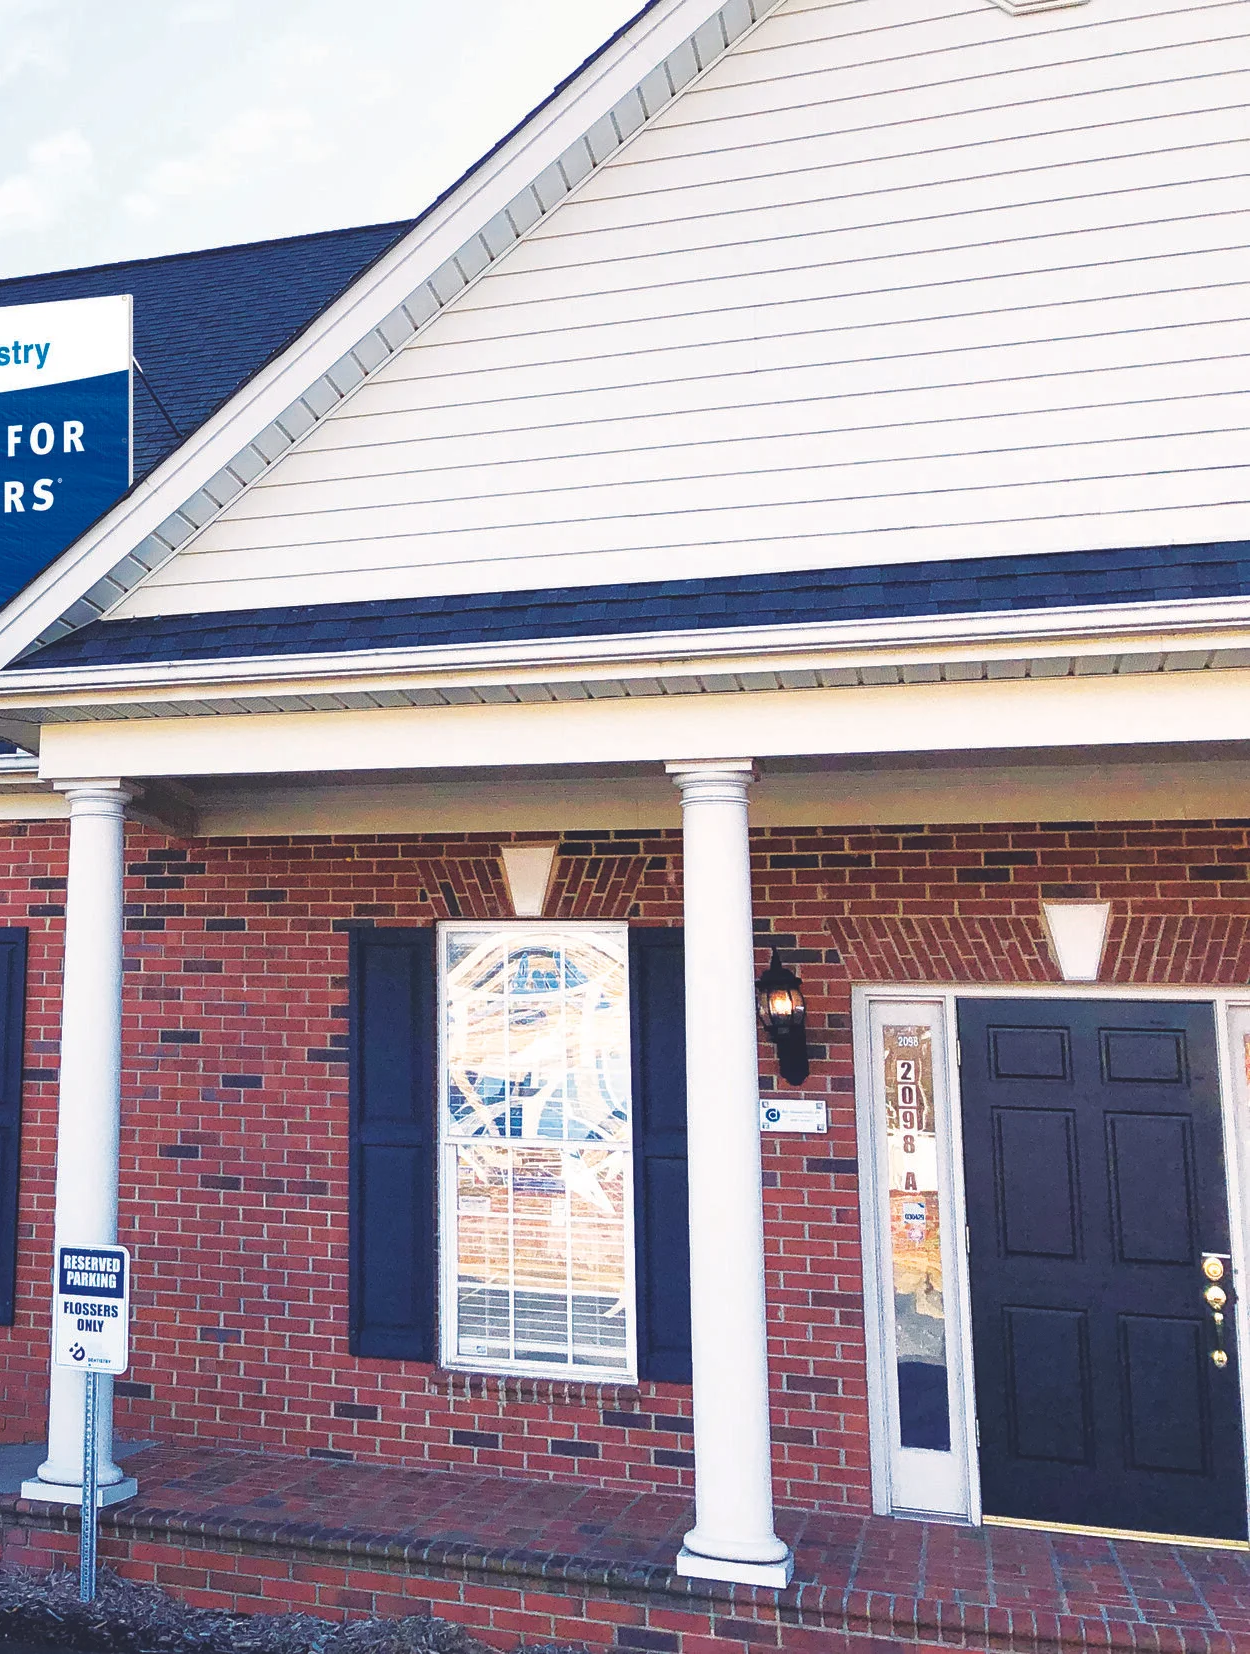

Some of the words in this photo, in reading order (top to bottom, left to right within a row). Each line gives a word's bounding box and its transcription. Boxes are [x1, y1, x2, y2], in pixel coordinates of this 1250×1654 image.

[7, 420, 85, 457] FOR
[897, 1036, 919, 1047] 2098
[63, 1254, 121, 1273] RESERVED
[66, 1270, 117, 1289] PARKING
[63, 1301, 119, 1318] FLOSSERS
[76, 1318, 105, 1333] ONLY
